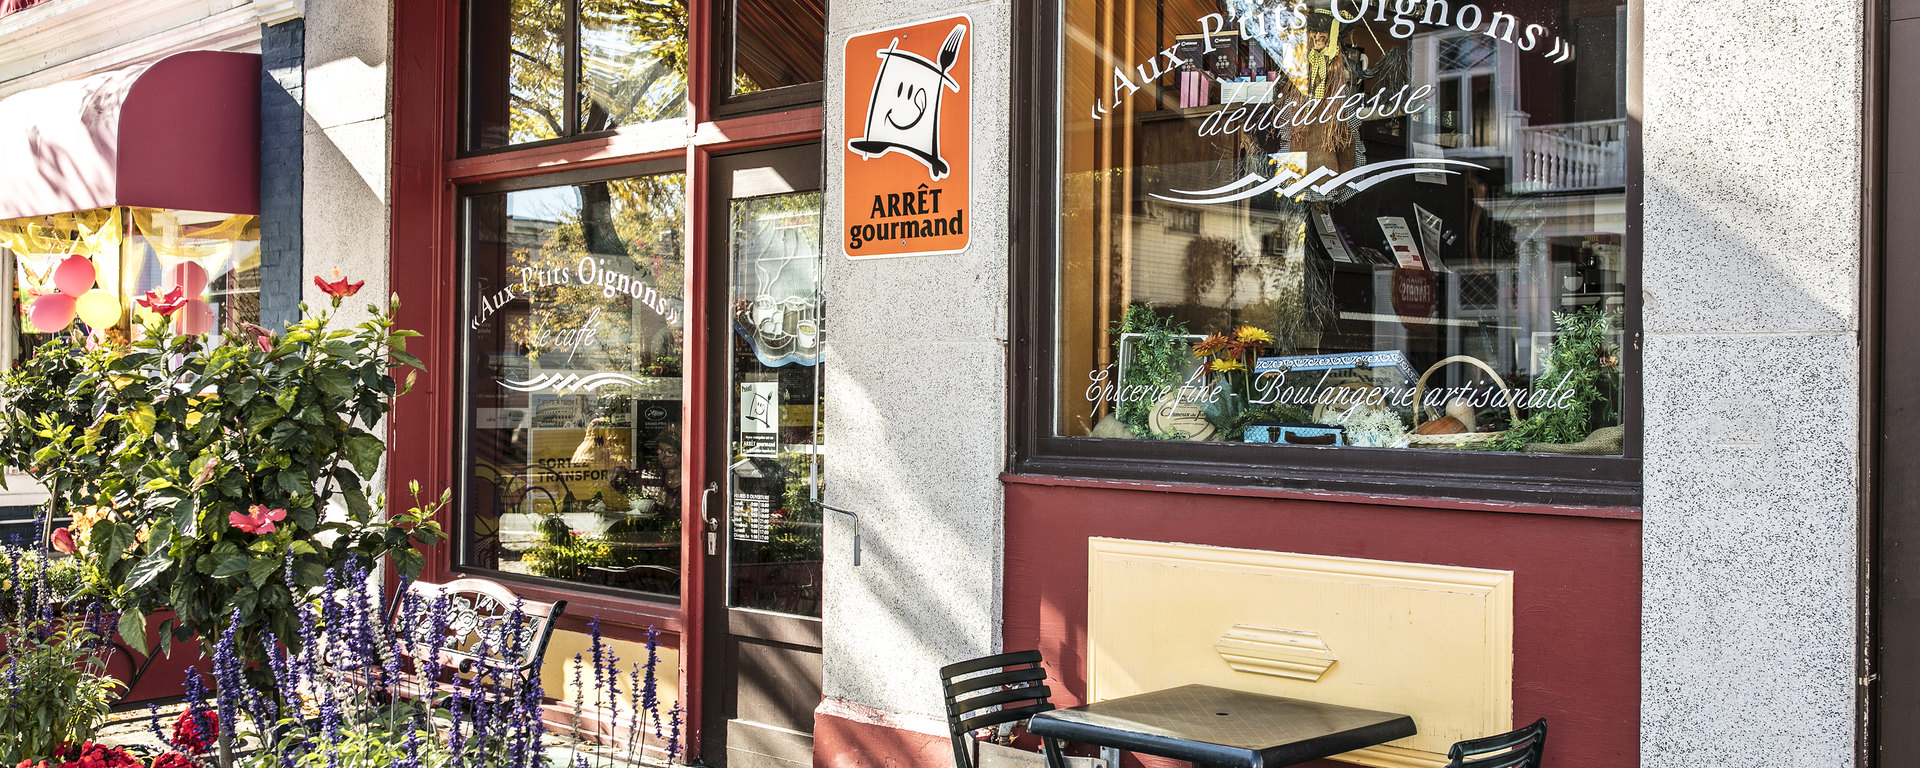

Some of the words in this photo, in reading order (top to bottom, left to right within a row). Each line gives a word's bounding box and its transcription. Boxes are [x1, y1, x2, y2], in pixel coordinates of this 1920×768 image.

[1198, 75, 1432, 138] délicatesse
[850, 209, 964, 249] gourmand
[870, 183, 942, 219] ARRÊT
[533, 312, 551, 348] le
[554, 307, 601, 363] café
[1085, 363, 1173, 418] Épicerie
[1167, 365, 1223, 419] fine
[1248, 367, 1418, 424] Boulangerie
[1425, 369, 1576, 410] artisanale
